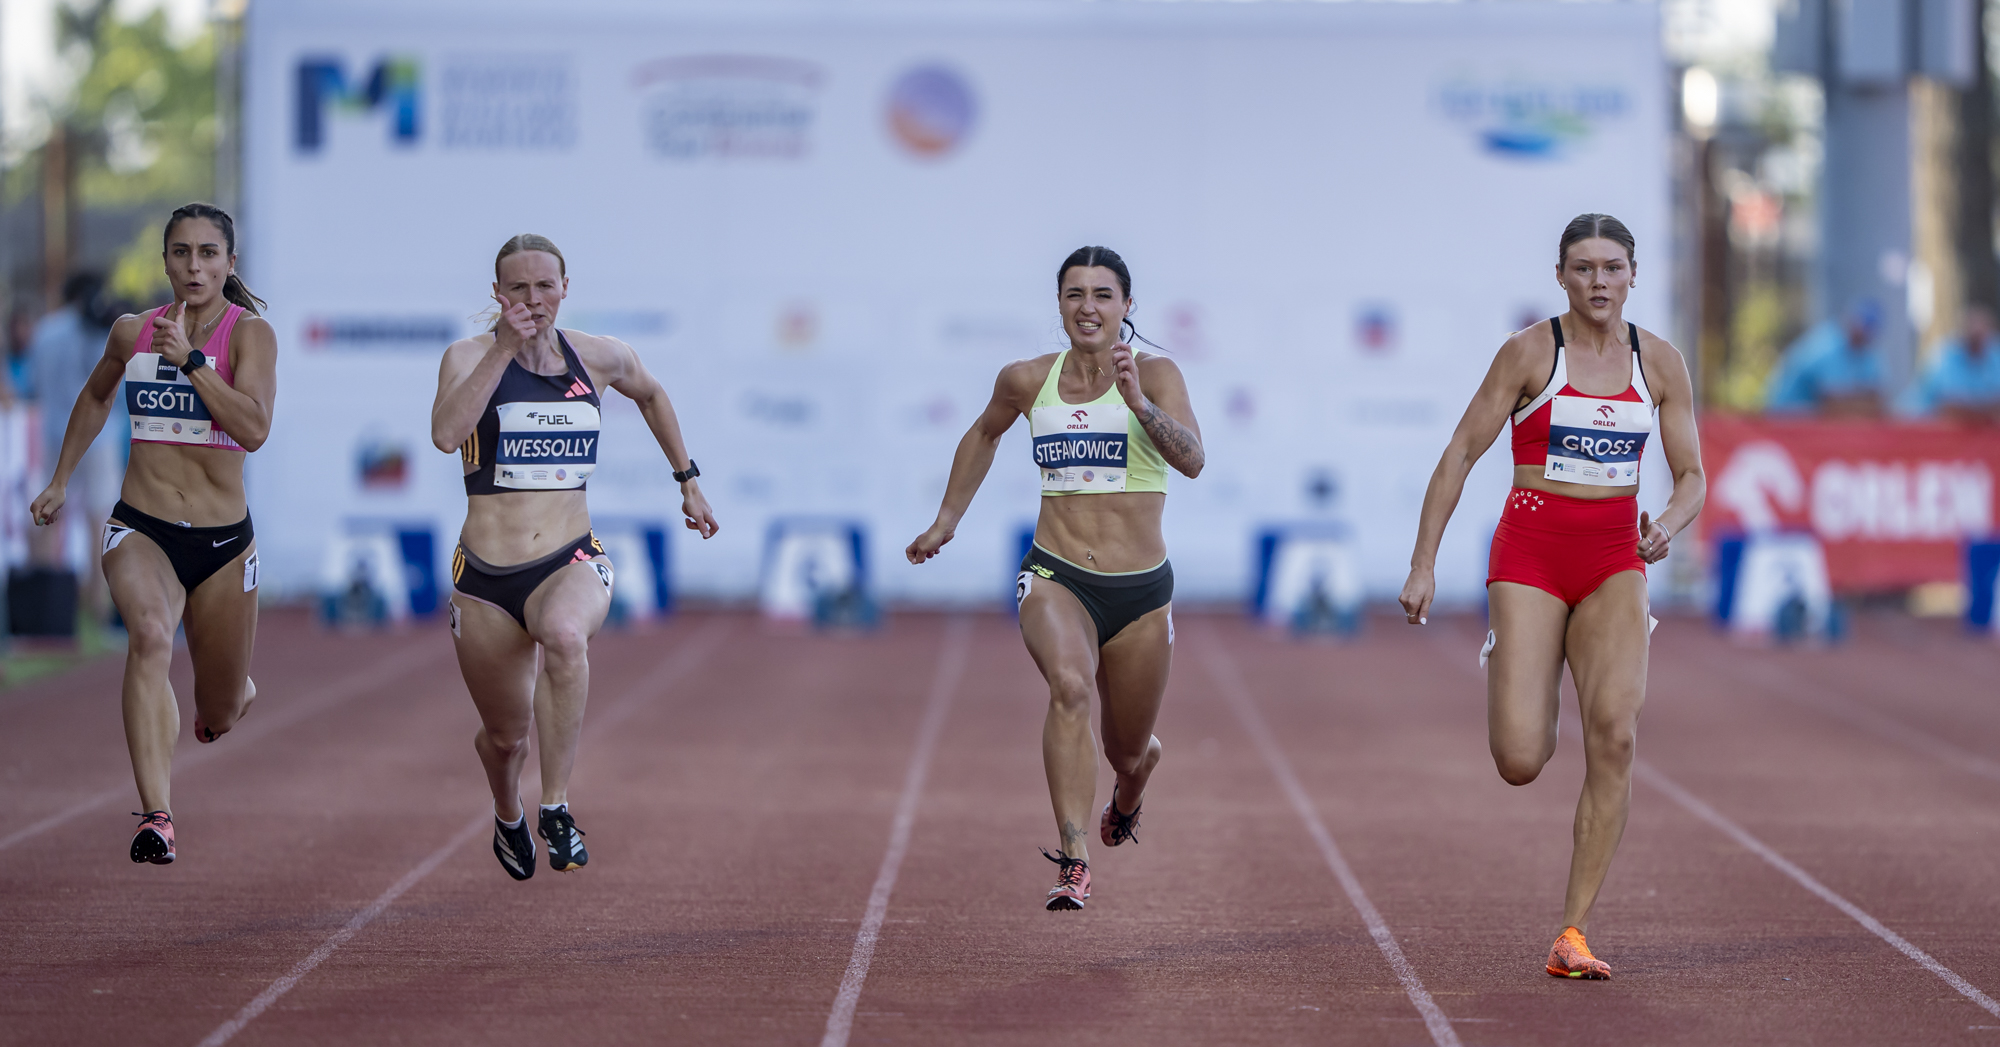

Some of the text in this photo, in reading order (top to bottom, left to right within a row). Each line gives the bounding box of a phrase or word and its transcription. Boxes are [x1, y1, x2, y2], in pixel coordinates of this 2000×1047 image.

[136, 386, 195, 412] CSÓTI
[538, 415, 574, 425] FUEL
[1593, 419, 1616, 427] ORLEN
[503, 438, 595, 458] WESSOLLY
[1036, 440, 1123, 463] STEFANOWICZ
[1562, 435, 1636, 457] GROSS
[106, 525, 124, 549] 7
